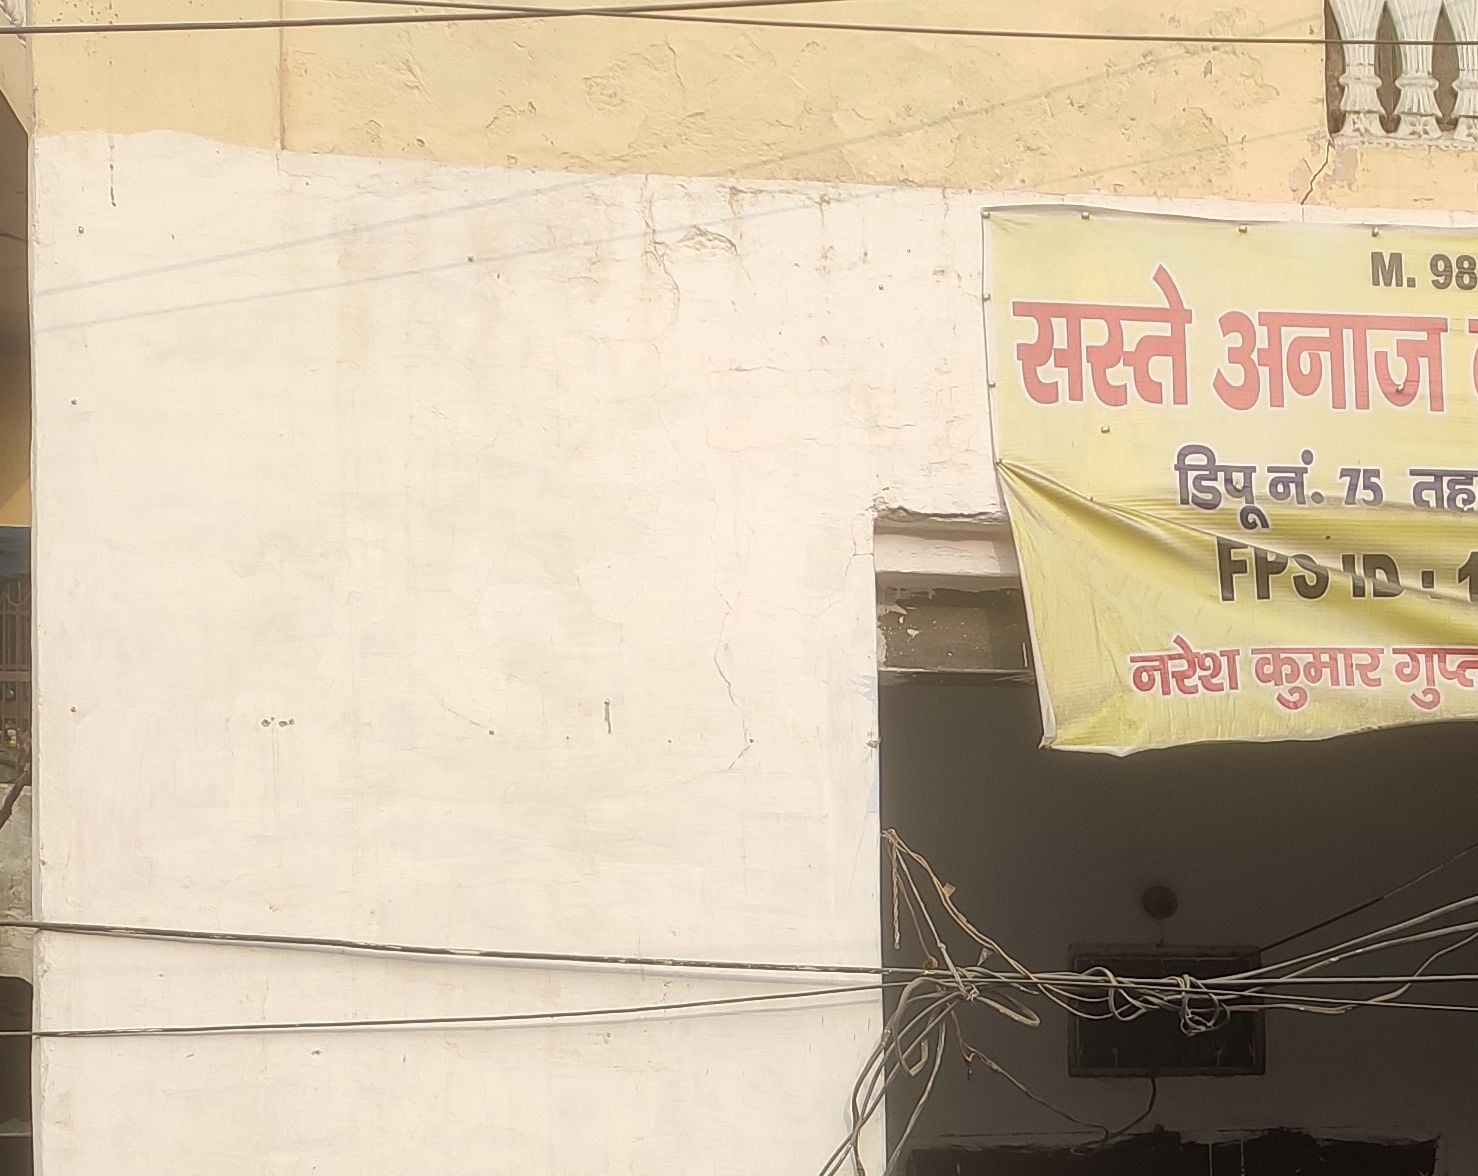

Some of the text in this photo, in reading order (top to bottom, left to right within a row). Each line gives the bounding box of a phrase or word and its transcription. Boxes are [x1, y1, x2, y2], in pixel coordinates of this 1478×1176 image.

[1370, 251, 1416, 288] M.
[1012, 264, 1193, 408] सस्ते
[1212, 310, 1449, 412] अनाज
[1173, 443, 1270, 529] डिपू
[1266, 448, 1325, 505] नं.
[1338, 467, 1385, 506] 75
[1215, 535, 1331, 602] FPS
[1341, 553, 1403, 599] ID
[1129, 635, 1241, 696] नरेश
[1250, 646, 1385, 711] कुमार
